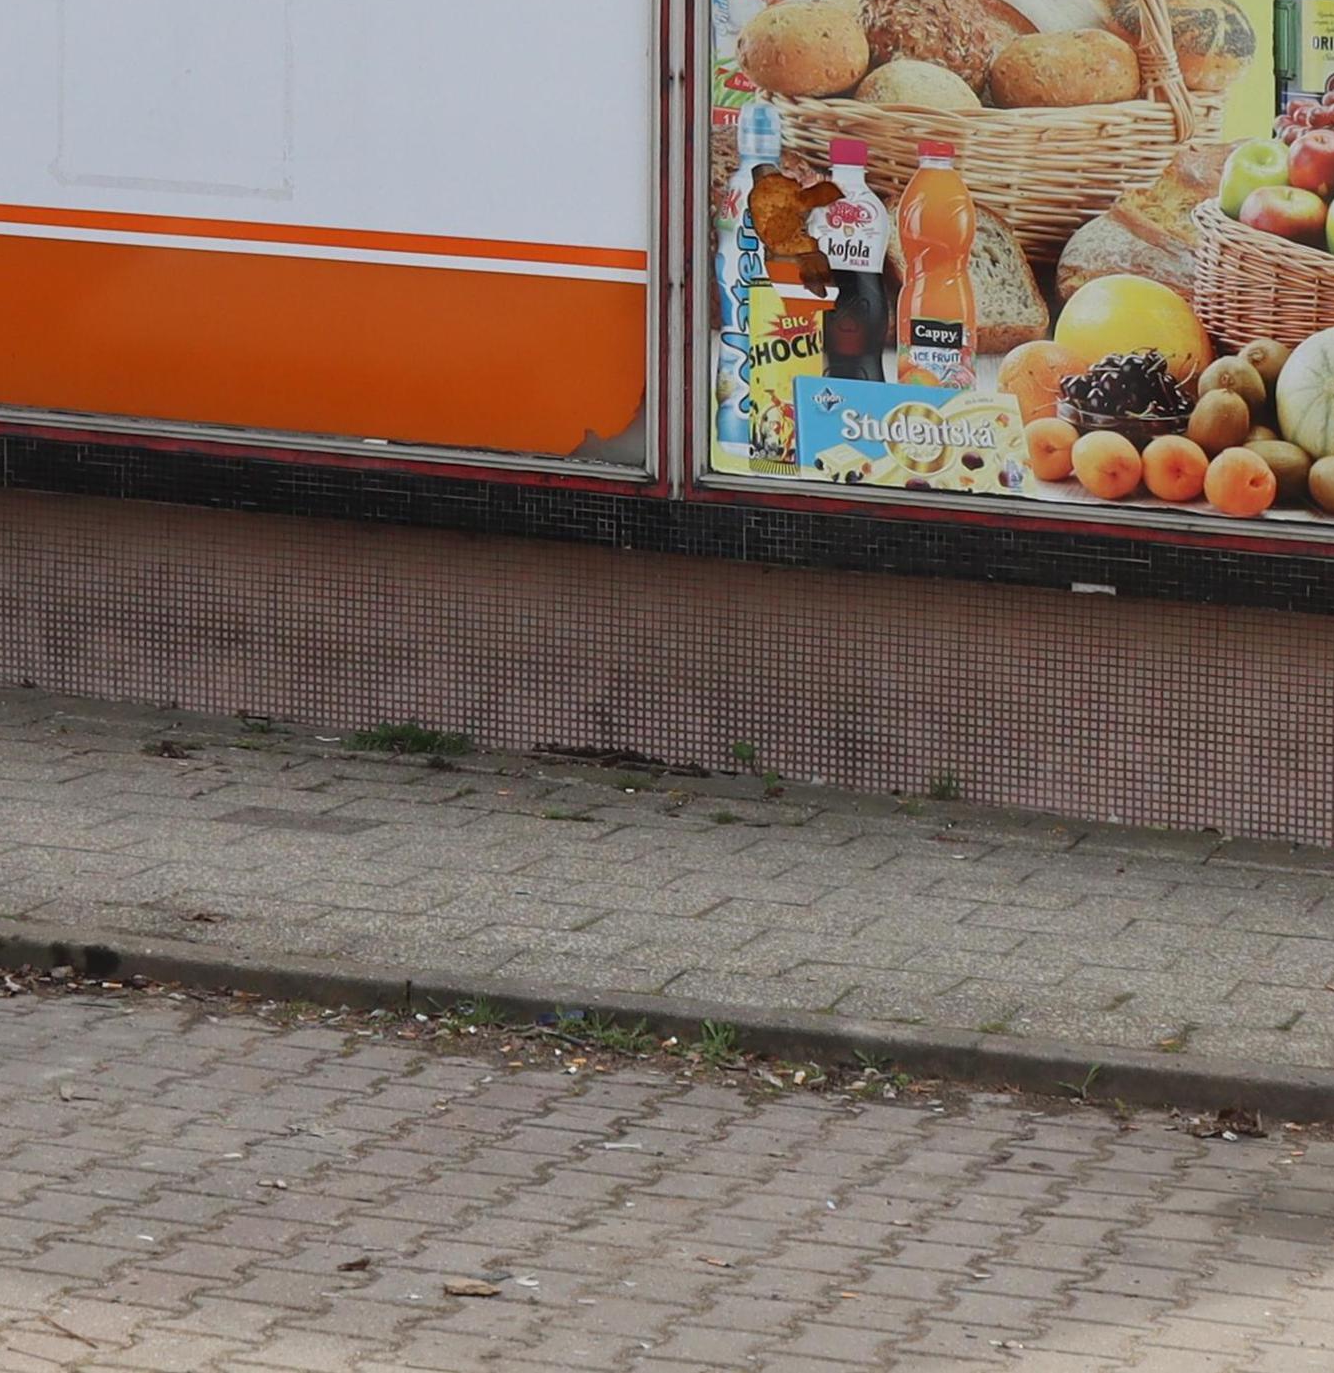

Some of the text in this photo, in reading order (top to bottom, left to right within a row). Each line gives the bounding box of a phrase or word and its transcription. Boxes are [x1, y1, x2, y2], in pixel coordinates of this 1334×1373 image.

[827, 237, 871, 262] kofola
[914, 324, 957, 343] Cappy
[932, 351, 960, 363] FRUIT
[840, 408, 997, 450] Studentská
